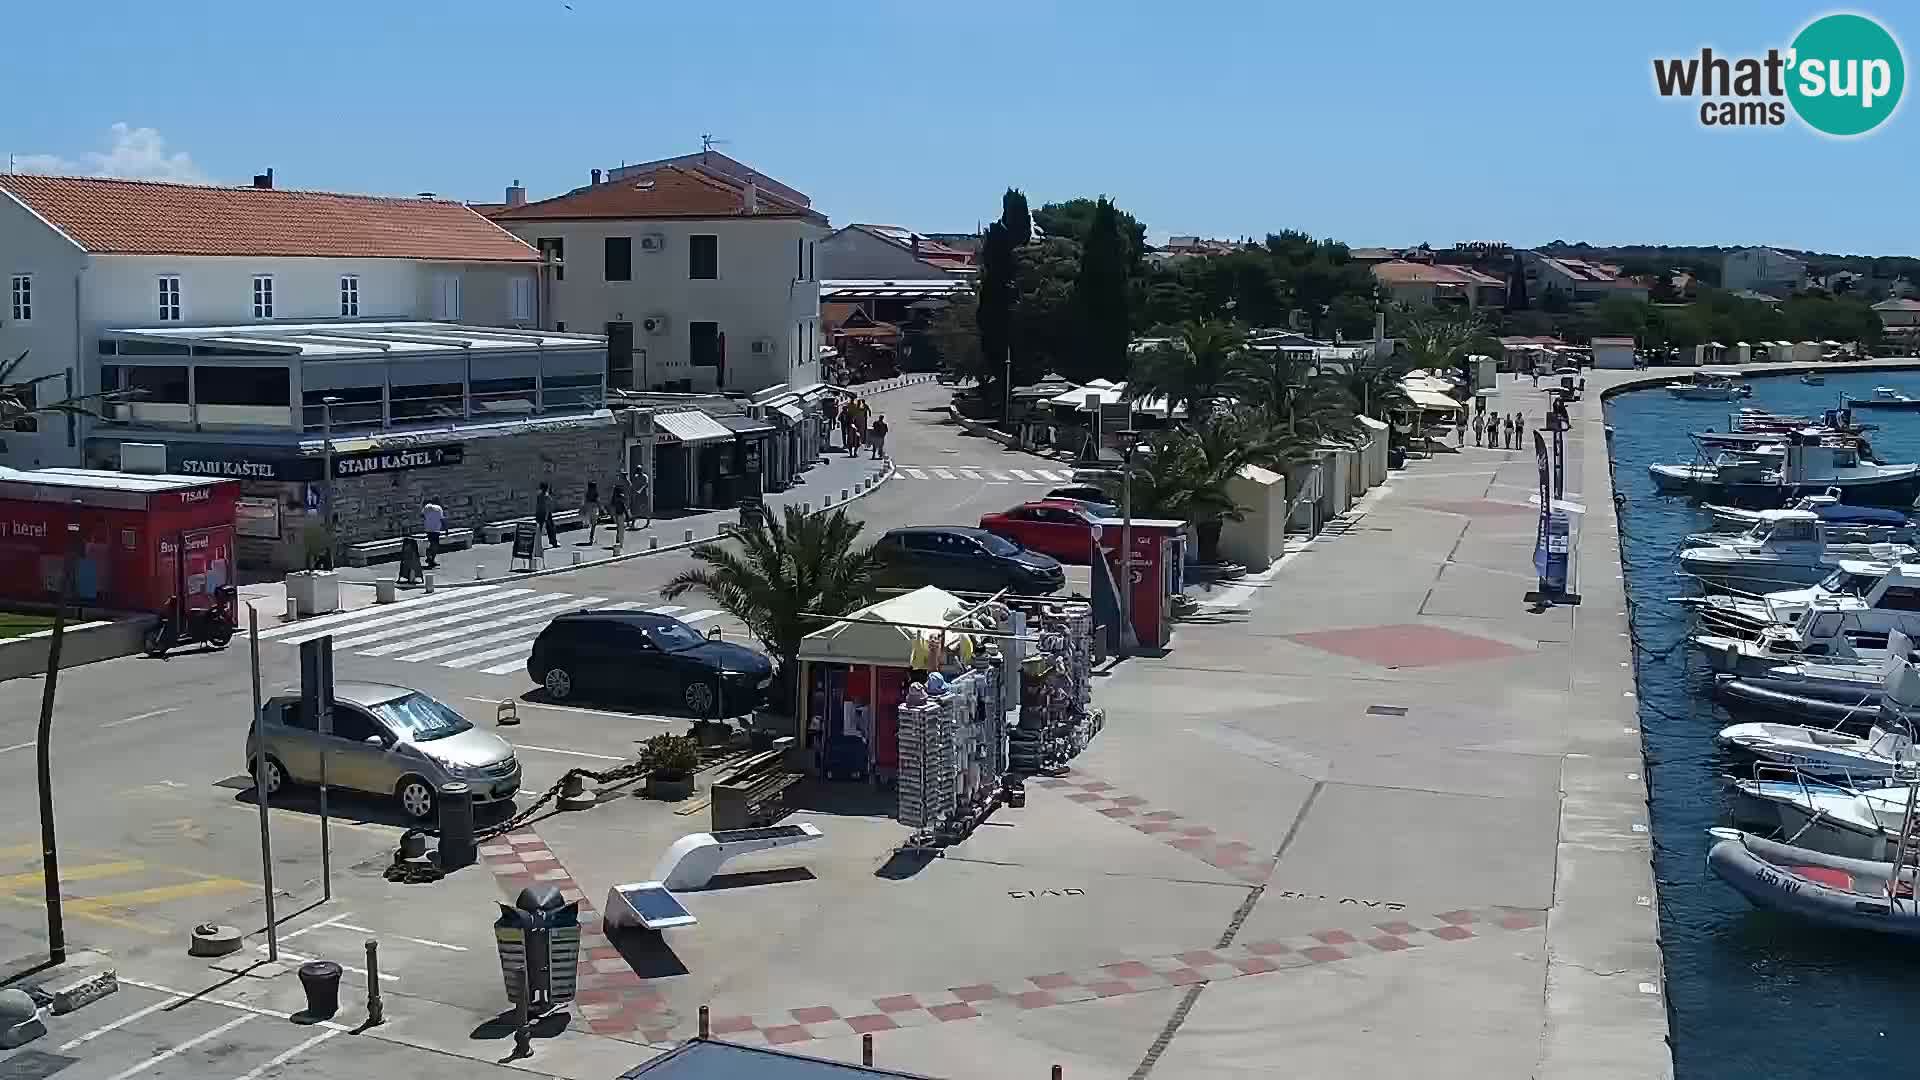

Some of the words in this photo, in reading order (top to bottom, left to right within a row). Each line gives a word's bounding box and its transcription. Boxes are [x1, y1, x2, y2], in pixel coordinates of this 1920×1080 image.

[183, 460, 220, 474] STARI
[223, 459, 275, 477] KAŠTEL
[339, 457, 378, 474] STARI
[381, 450, 432, 469] KAŠTEL
[180, 488, 210, 504] TISAK
